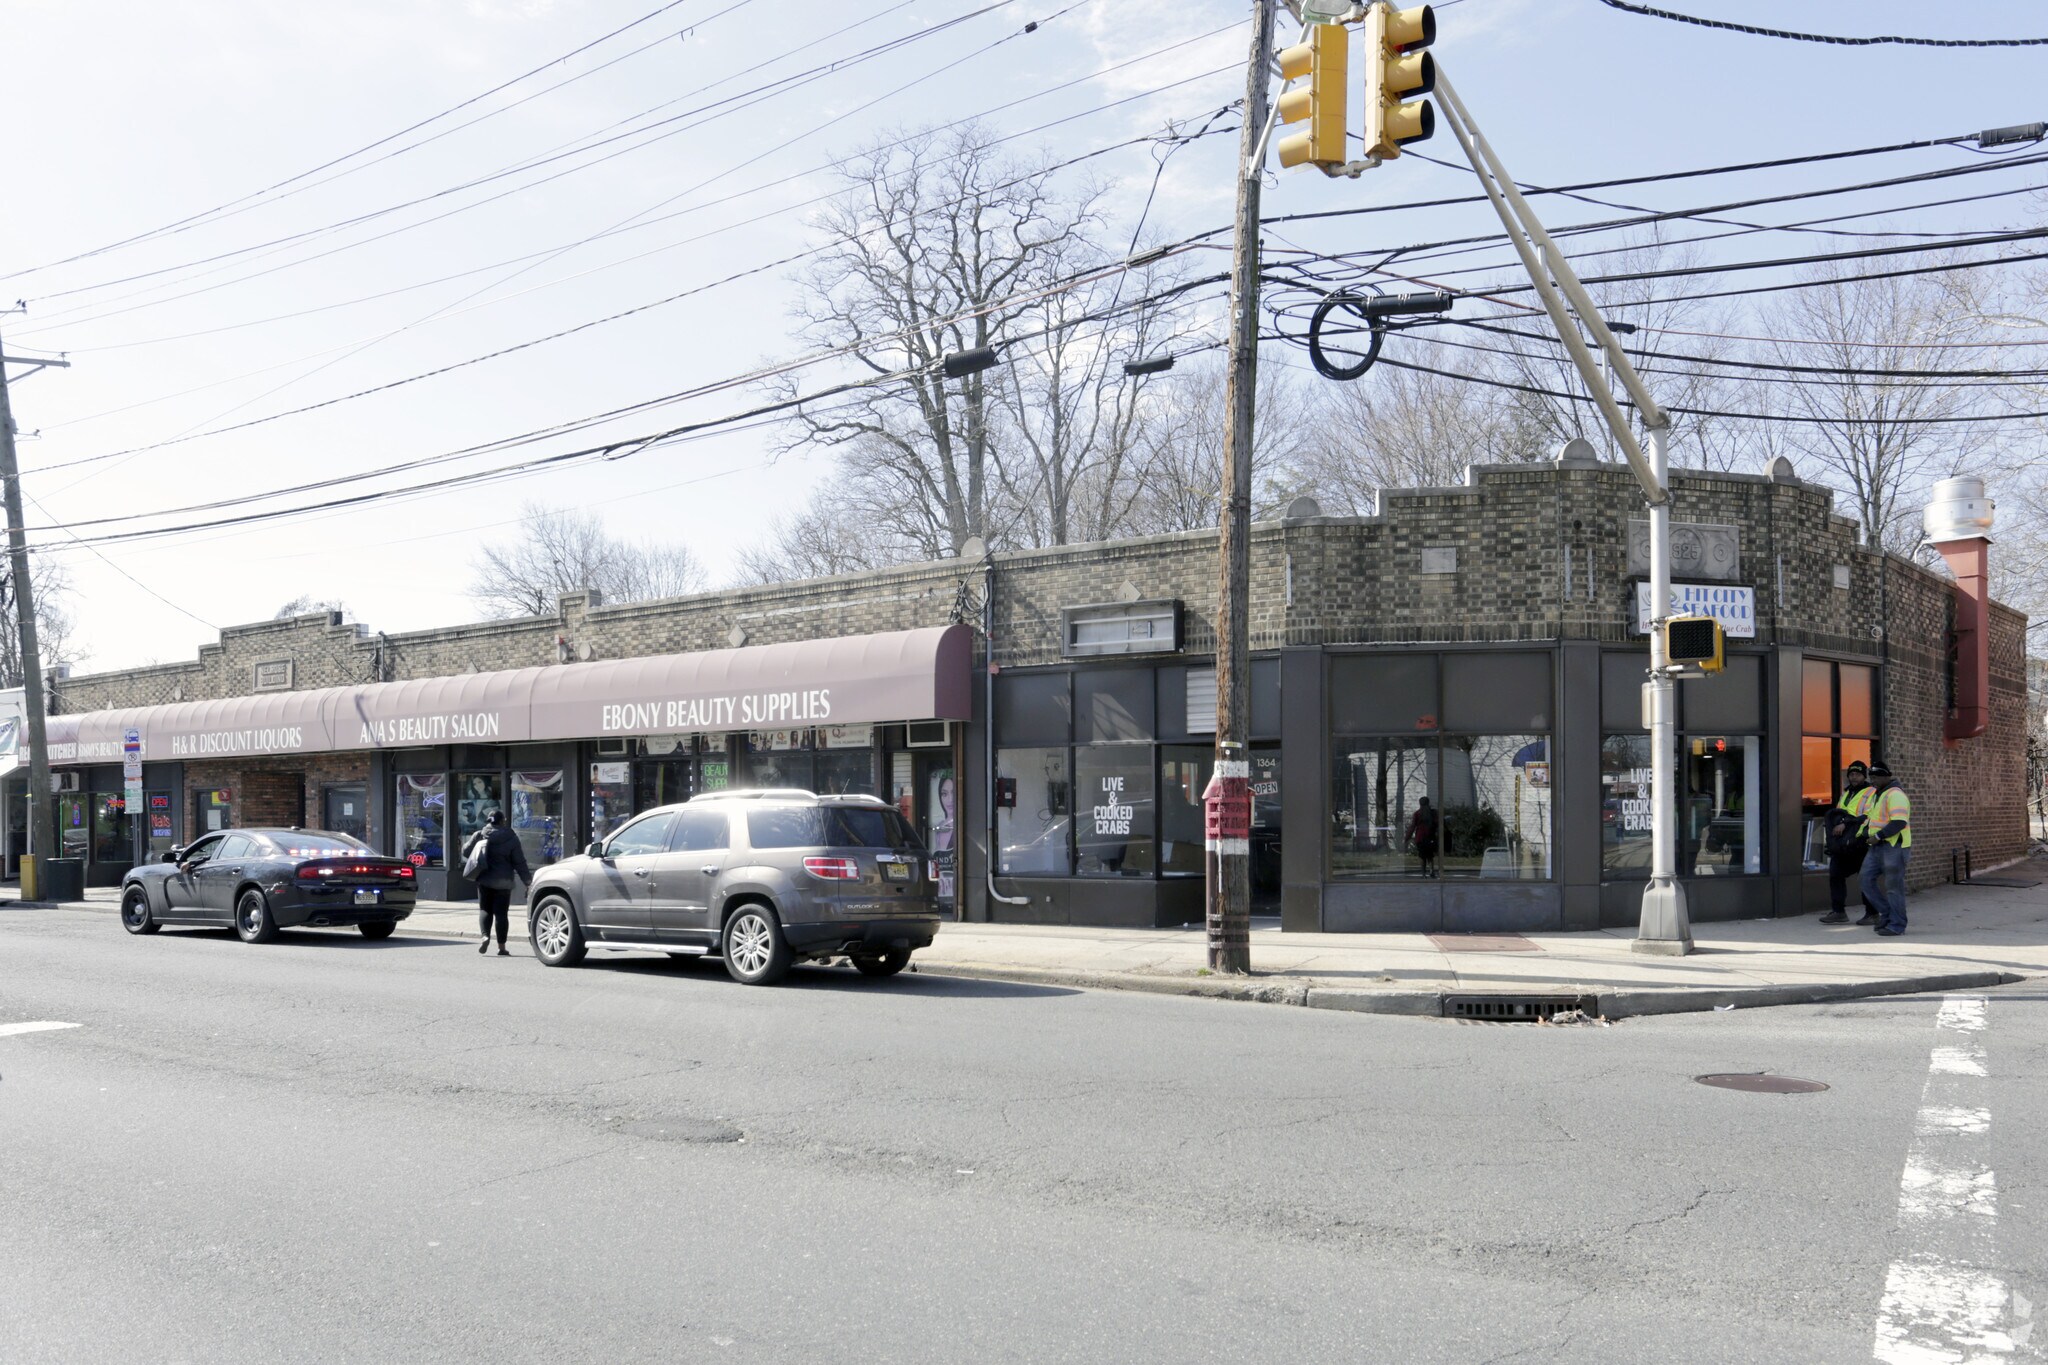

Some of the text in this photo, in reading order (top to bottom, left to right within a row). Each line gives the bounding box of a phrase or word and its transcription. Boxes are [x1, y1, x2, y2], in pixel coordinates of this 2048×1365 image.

[1671, 542, 1700, 560] 925
[1684, 587, 1748, 603] HIT CITY
[1682, 602, 1752, 619] SEAFOOD
[1736, 624, 1752, 633] Crab
[602, 689, 831, 731] EBONY BEAUTY SUPPLIES
[359, 712, 499, 743] ANA S BEAUTY SALON
[200, 730, 252, 753] DISCOUNT
[254, 726, 302, 752] LIQUORS
[47, 742, 77, 761] KITCHEN
[99, 741, 120, 756] BEAUTY
[1256, 758, 1276, 767] 1364
[703, 764, 729, 777] BEAU
[1630, 768, 1653, 783] LIVE
[1102, 777, 1124, 791] LIVE
[1254, 782, 1278, 794] OPEN
[1637, 783, 1648, 799] &
[151, 796, 168, 807] OPEN
[1108, 791, 1118, 805] &
[1093, 806, 1133, 820] COOKED
[1621, 799, 1653, 815] COOK
[151, 814, 171, 828] Nails
[1096, 820, 1130, 835] CRABS
[1624, 815, 1653, 831] CRAB
[407, 853, 427, 866] OPEN
